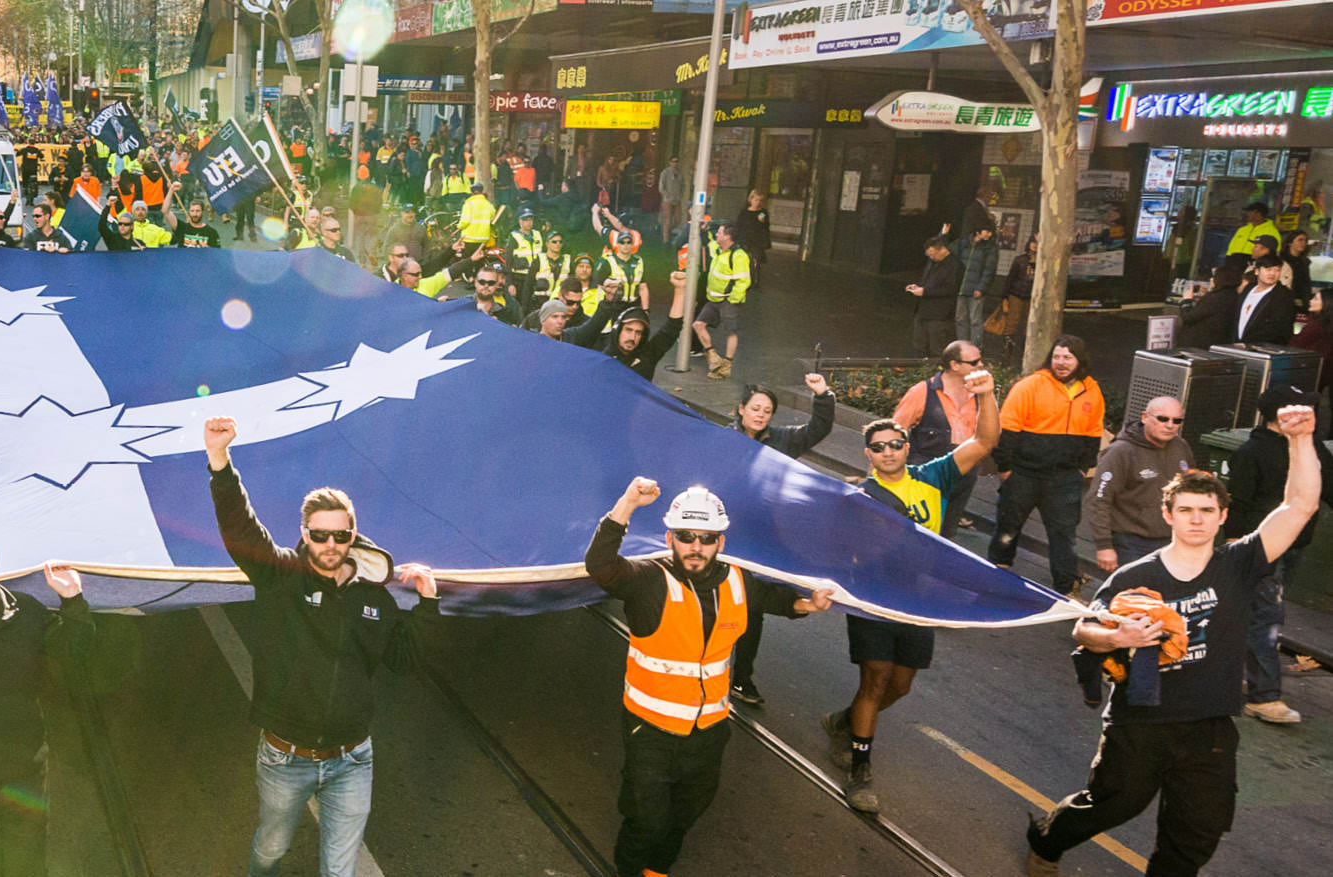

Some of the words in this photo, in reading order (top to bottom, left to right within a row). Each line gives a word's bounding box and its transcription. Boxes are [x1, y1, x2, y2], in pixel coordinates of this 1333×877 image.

[1118, 0, 1202, 14] ODYSSE
[749, 7, 821, 32] EXTRAGREEN
[496, 92, 519, 111] pie
[523, 93, 557, 109] face
[1136, 90, 1297, 118] EXTRAGREEN
[955, 106, 1034, 127] 長青旅遊
